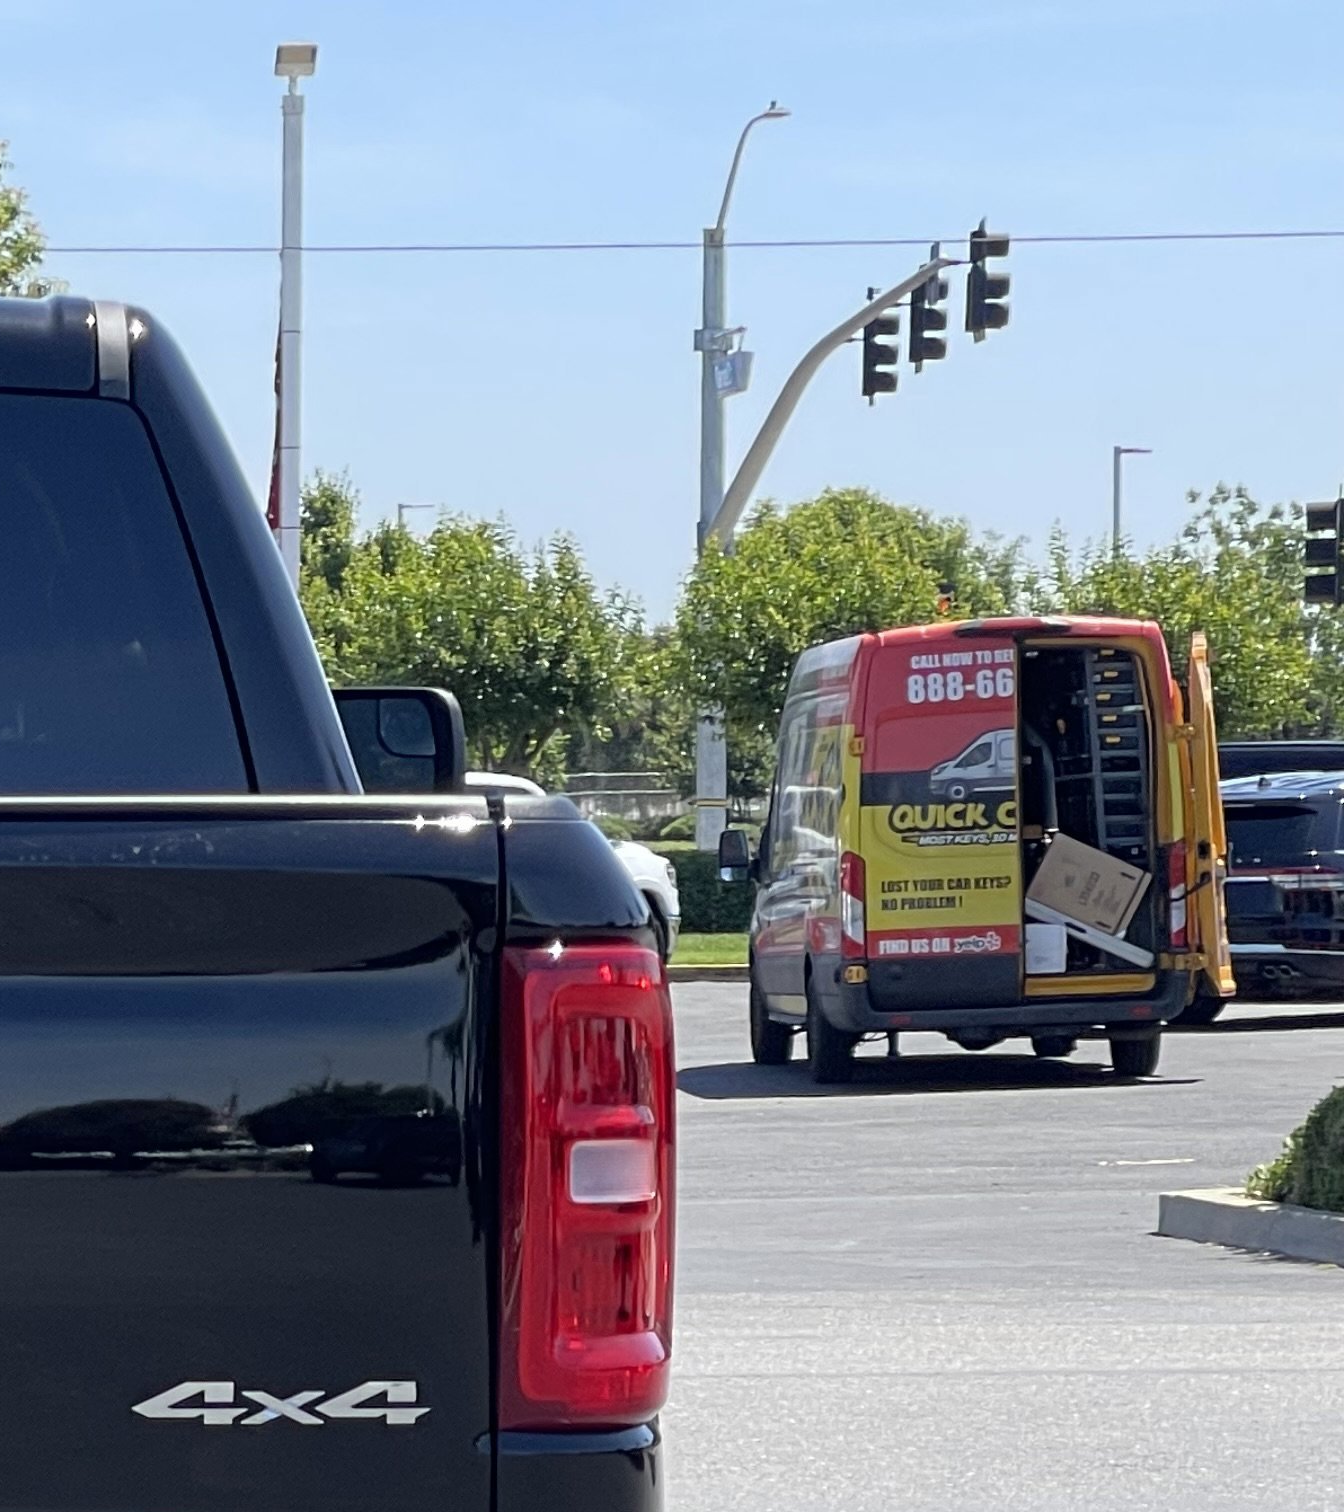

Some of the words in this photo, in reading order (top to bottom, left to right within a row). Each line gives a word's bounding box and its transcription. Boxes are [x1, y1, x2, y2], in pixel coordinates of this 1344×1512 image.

[911, 654, 941, 669] CALL
[942, 652, 973, 666] NOW
[975, 650, 992, 664] TO
[892, 802, 989, 830] QUICK
[918, 835, 953, 845] MOST
[881, 881, 910, 893] LOST
[912, 879, 944, 892] YOUR
[947, 878, 972, 890] CAR
[974, 876, 1011, 889] KEYS?
[881, 899, 898, 911] NO
[901, 896, 956, 910] PROBLEM
[879, 940, 909, 955] FIND
[911, 939, 929, 953] US
[932, 938, 951, 953] ON
[955, 935, 986, 953] yelp
[131, 1381, 432, 1424] 4x4
